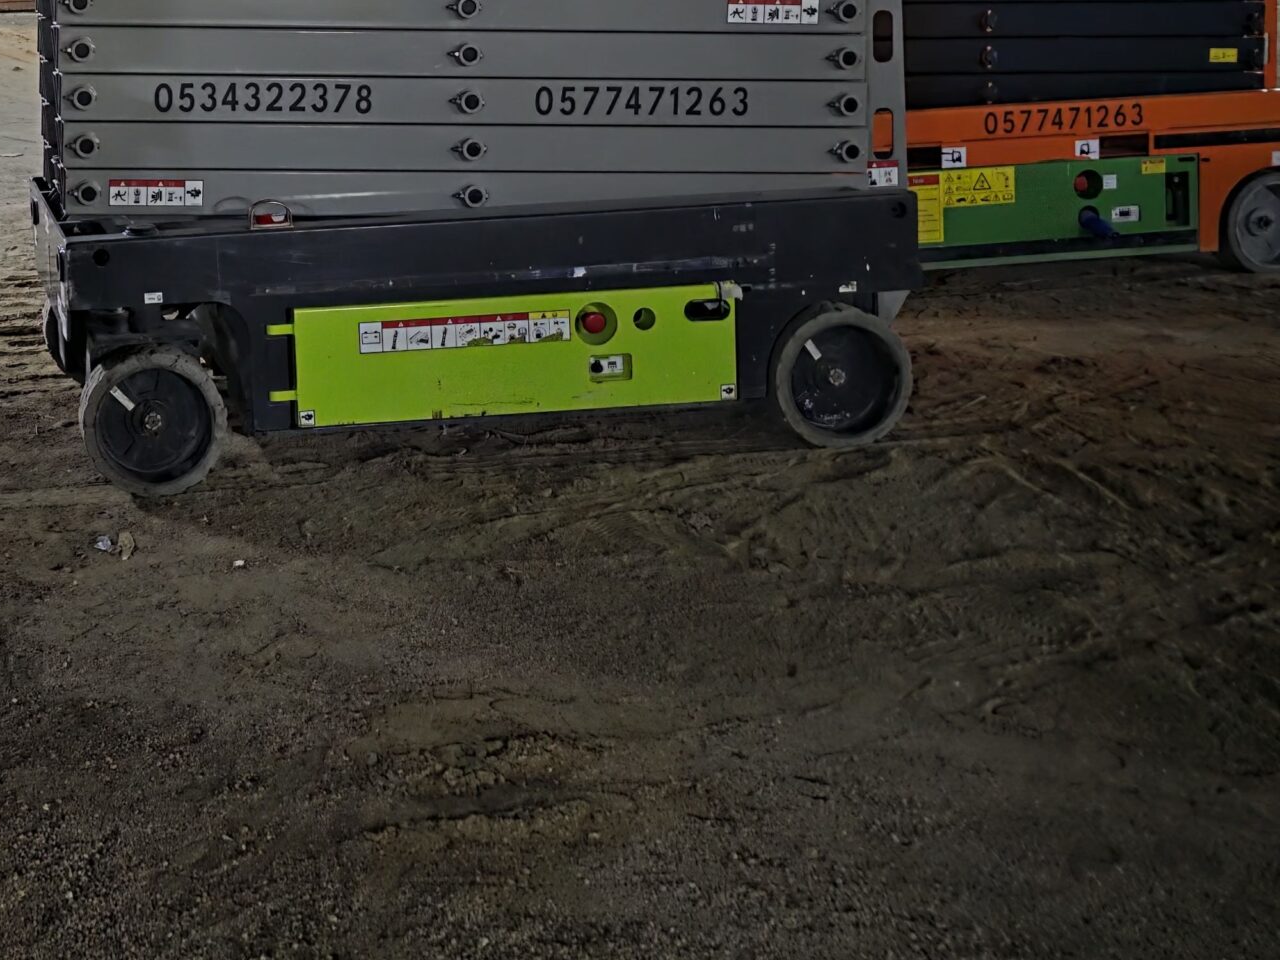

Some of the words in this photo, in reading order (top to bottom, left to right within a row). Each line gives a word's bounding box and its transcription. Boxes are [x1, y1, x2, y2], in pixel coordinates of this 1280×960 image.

[154, 83, 373, 115] 0534322378
[535, 86, 749, 117] 0577471263
[983, 103, 1144, 135] 0577471263
